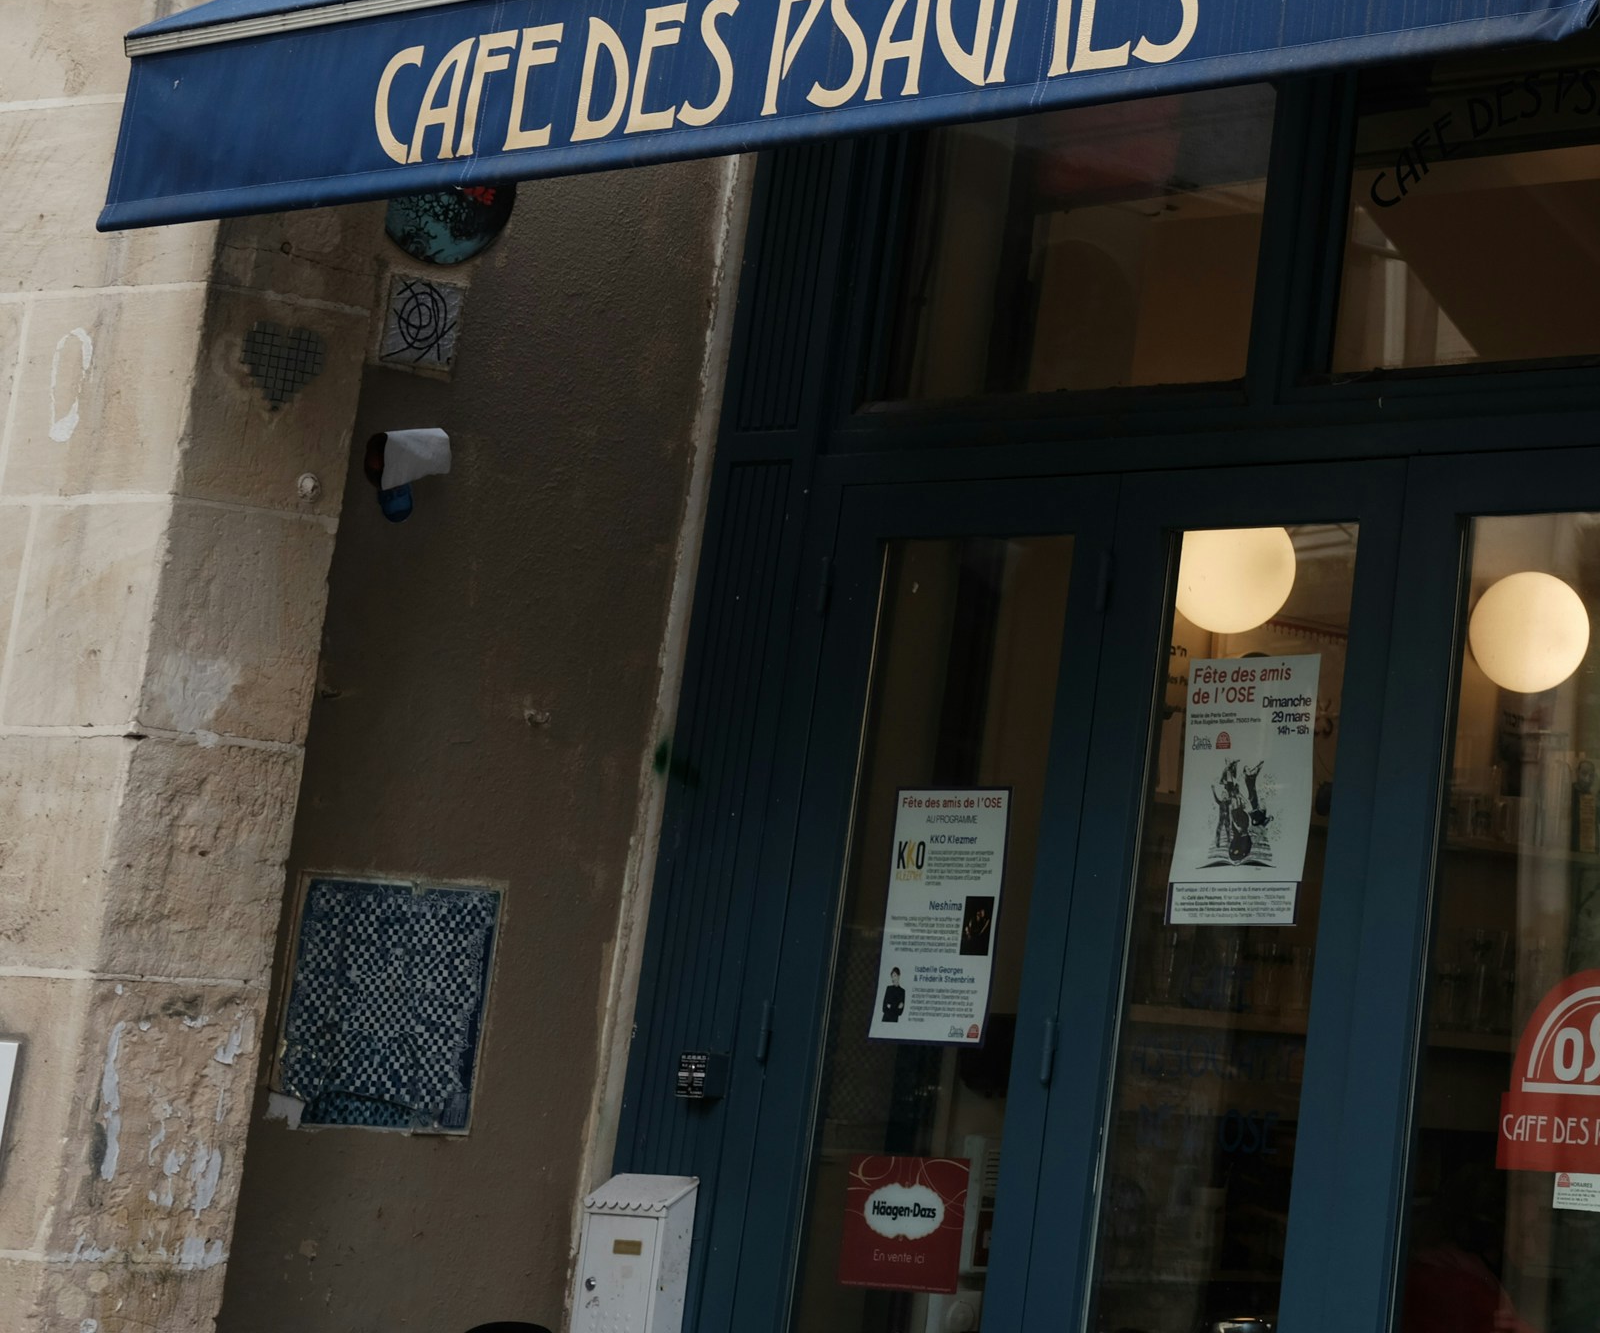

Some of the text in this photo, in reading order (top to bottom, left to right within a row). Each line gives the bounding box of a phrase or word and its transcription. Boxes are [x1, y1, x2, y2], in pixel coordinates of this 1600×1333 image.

[373, 21, 565, 166] CAFE
[1194, 665, 1228, 684] Fête
[1231, 666, 1257, 683] des
[1259, 662, 1292, 682] amis
[1192, 688, 1210, 705] de
[1262, 694, 1312, 708] Dimanche
[1271, 711, 1310, 723] 29 mars
[902, 796, 923, 808] Fête
[925, 797, 940, 808] des
[942, 796, 962, 808] amis
[963, 797, 975, 808] de
[930, 834, 978, 846] KKO Klezmer
[896, 840, 926, 869] KKO
[929, 899, 962, 912] Neshima
[1502, 1113, 1548, 1143] CAFE
[1552, 1117, 1589, 1145] DES
[873, 1248, 925, 1264] En vente ici
